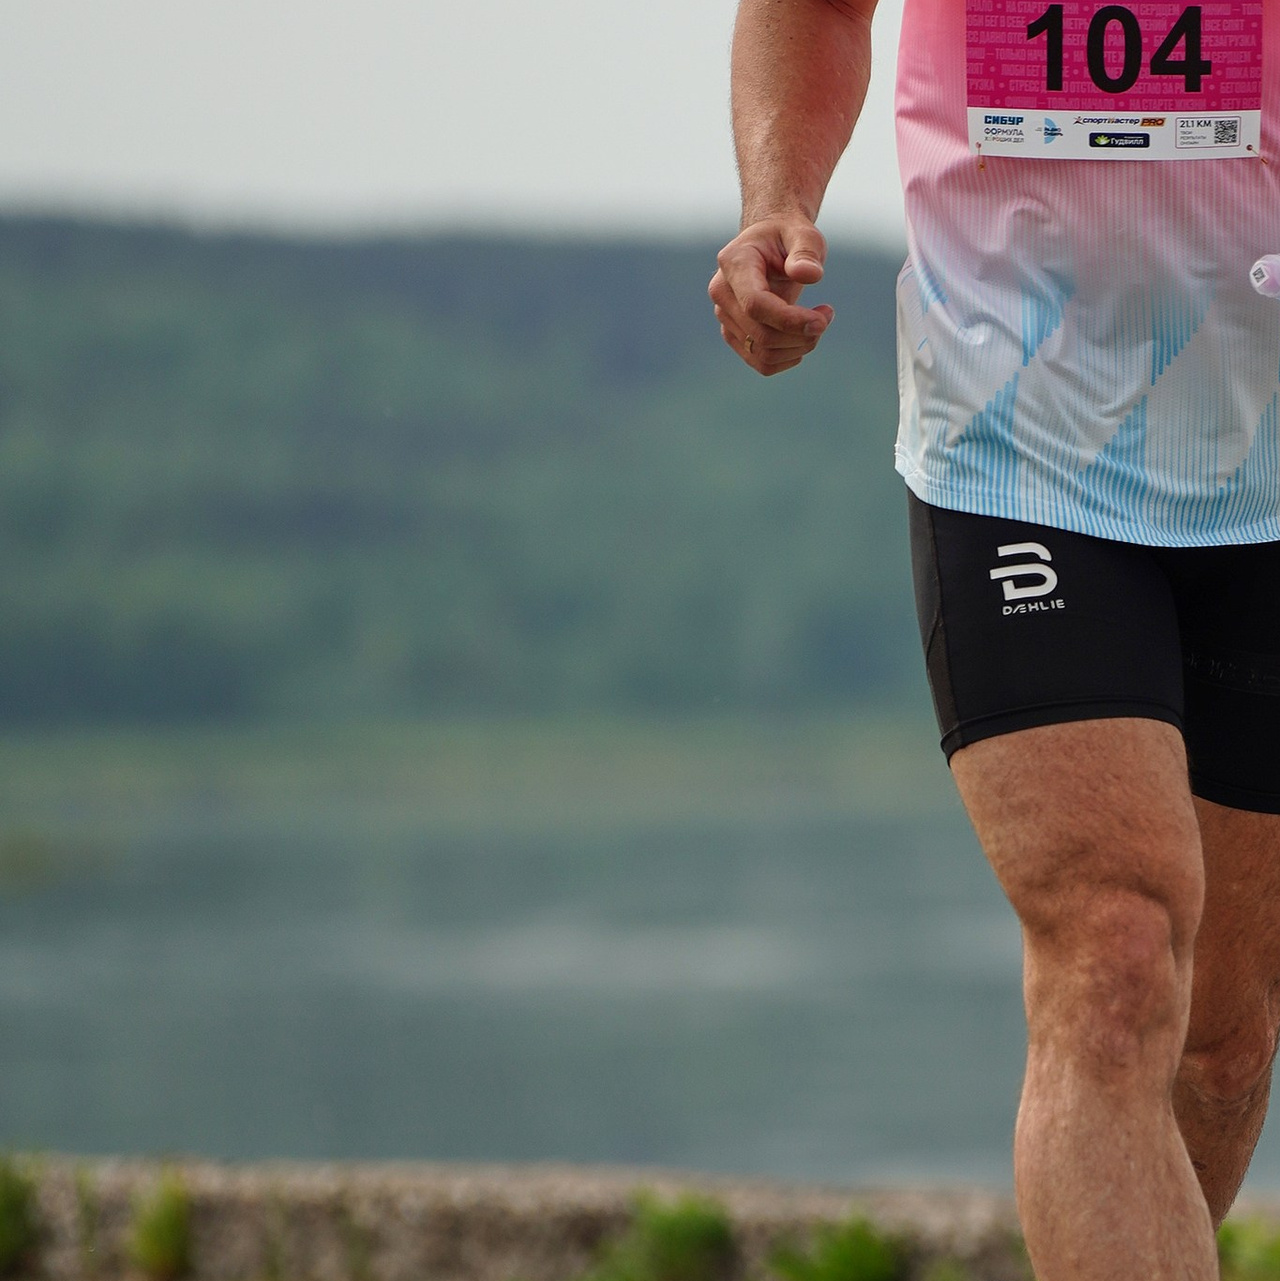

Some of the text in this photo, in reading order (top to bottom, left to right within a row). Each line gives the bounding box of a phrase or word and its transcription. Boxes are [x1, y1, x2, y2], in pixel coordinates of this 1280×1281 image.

[1027, 3, 1212, 94] 104
[984, 115, 1023, 125] СИБУР
[984, 127, 1024, 136] ФОРМУЛА
